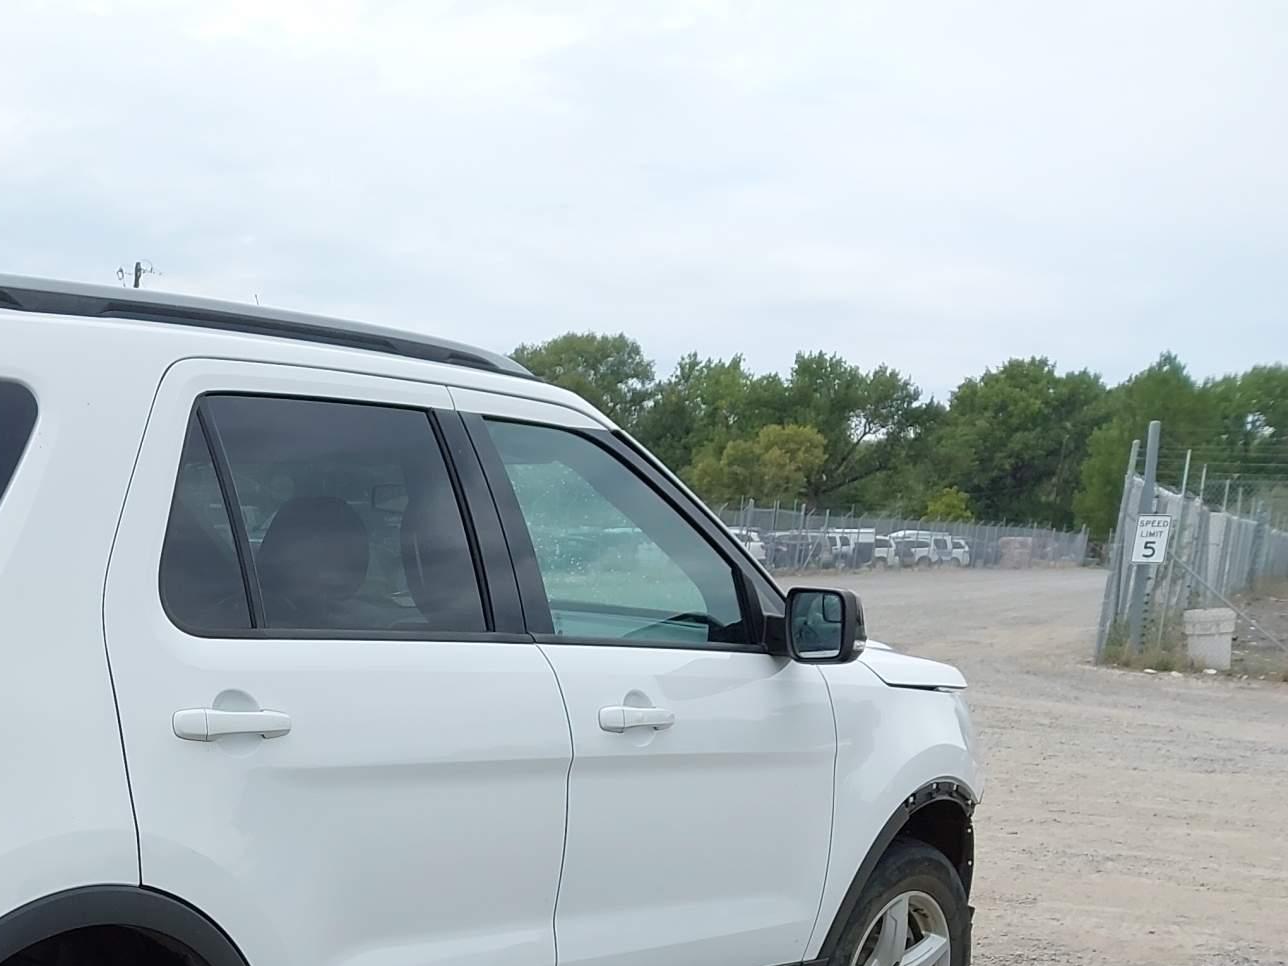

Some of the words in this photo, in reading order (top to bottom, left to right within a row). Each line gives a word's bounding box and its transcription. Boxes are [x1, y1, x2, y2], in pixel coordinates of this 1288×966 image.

[1139, 519, 1169, 527] SPEED
[1140, 530, 1164, 538] LIMIT
[1142, 541, 1156, 558] 5
